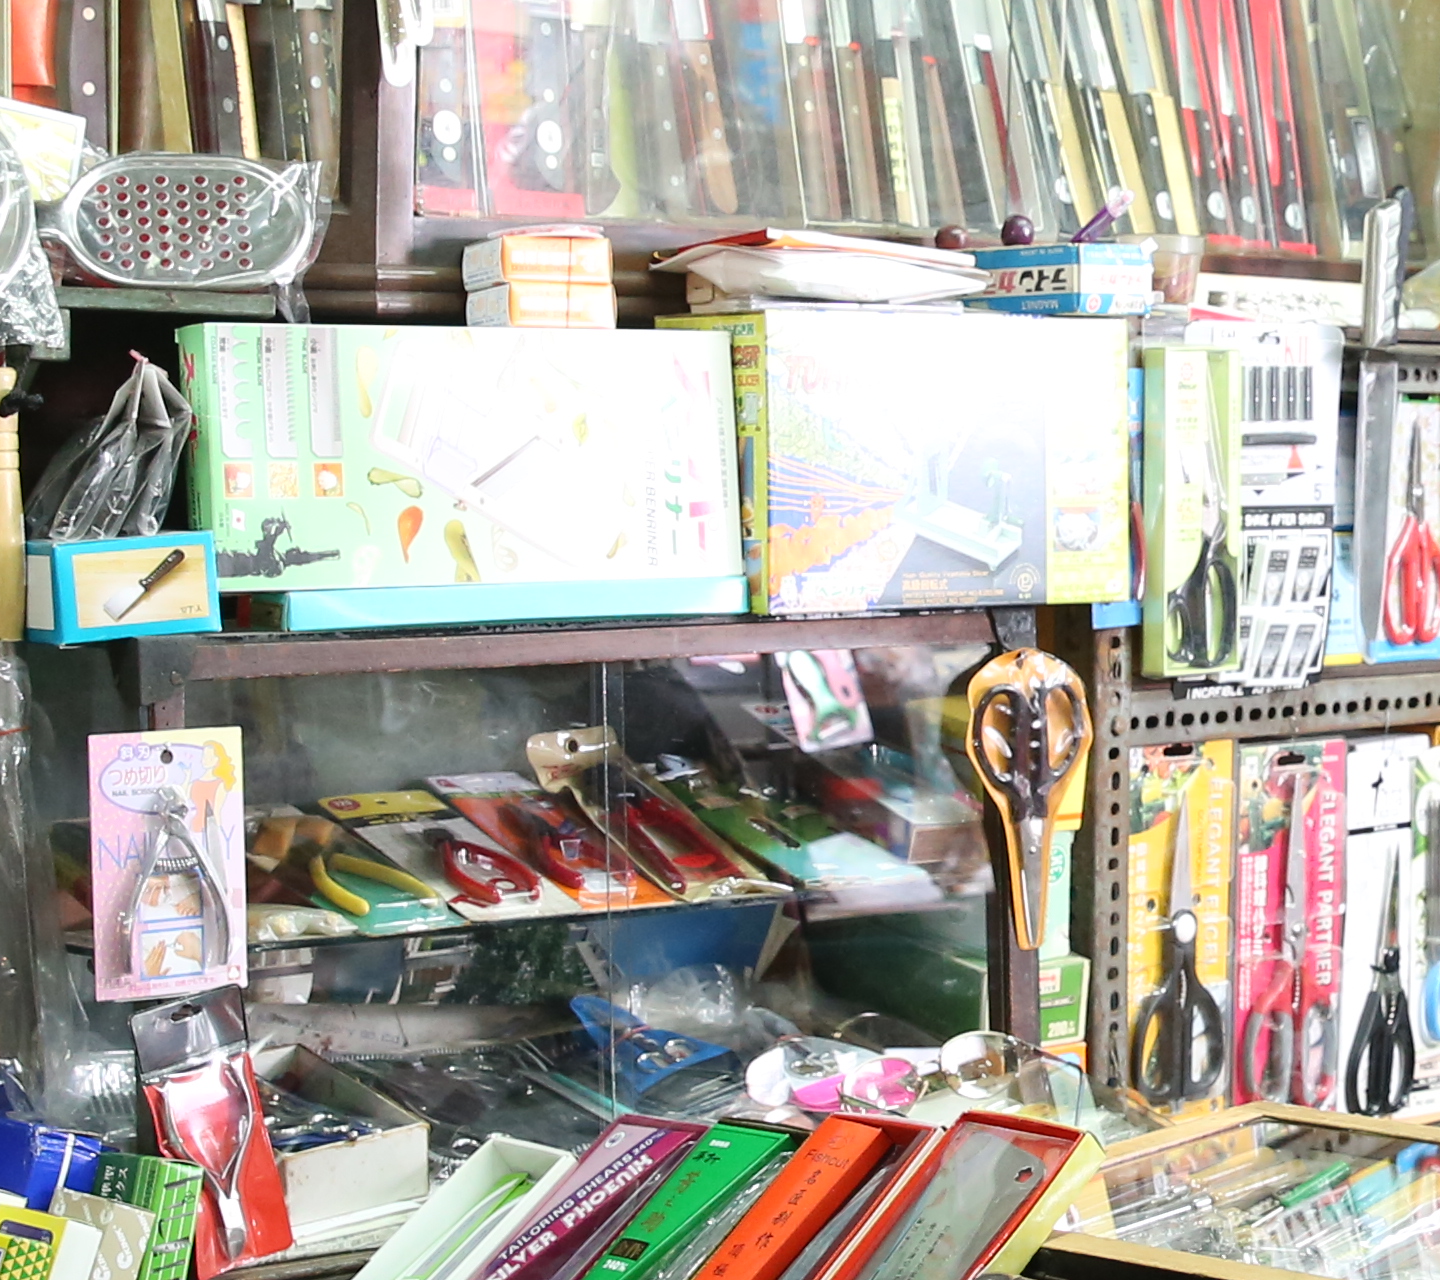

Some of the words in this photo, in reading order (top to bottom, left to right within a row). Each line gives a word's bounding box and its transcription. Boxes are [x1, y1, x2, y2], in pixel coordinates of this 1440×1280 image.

[1020, 299, 1059, 311] MAGNET
[645, 486, 659, 567] BENRINER
[108, 765, 167, 787] つめ切り
[1203, 776, 1226, 888] ELEGANT
[1316, 788, 1338, 886] ELEGANT
[1314, 890, 1334, 988] PARTNER
[496, 1194, 576, 1260] TAILORING
[567, 1152, 633, 1207] SHEARS
[562, 1153, 654, 1229] PHOENIX
